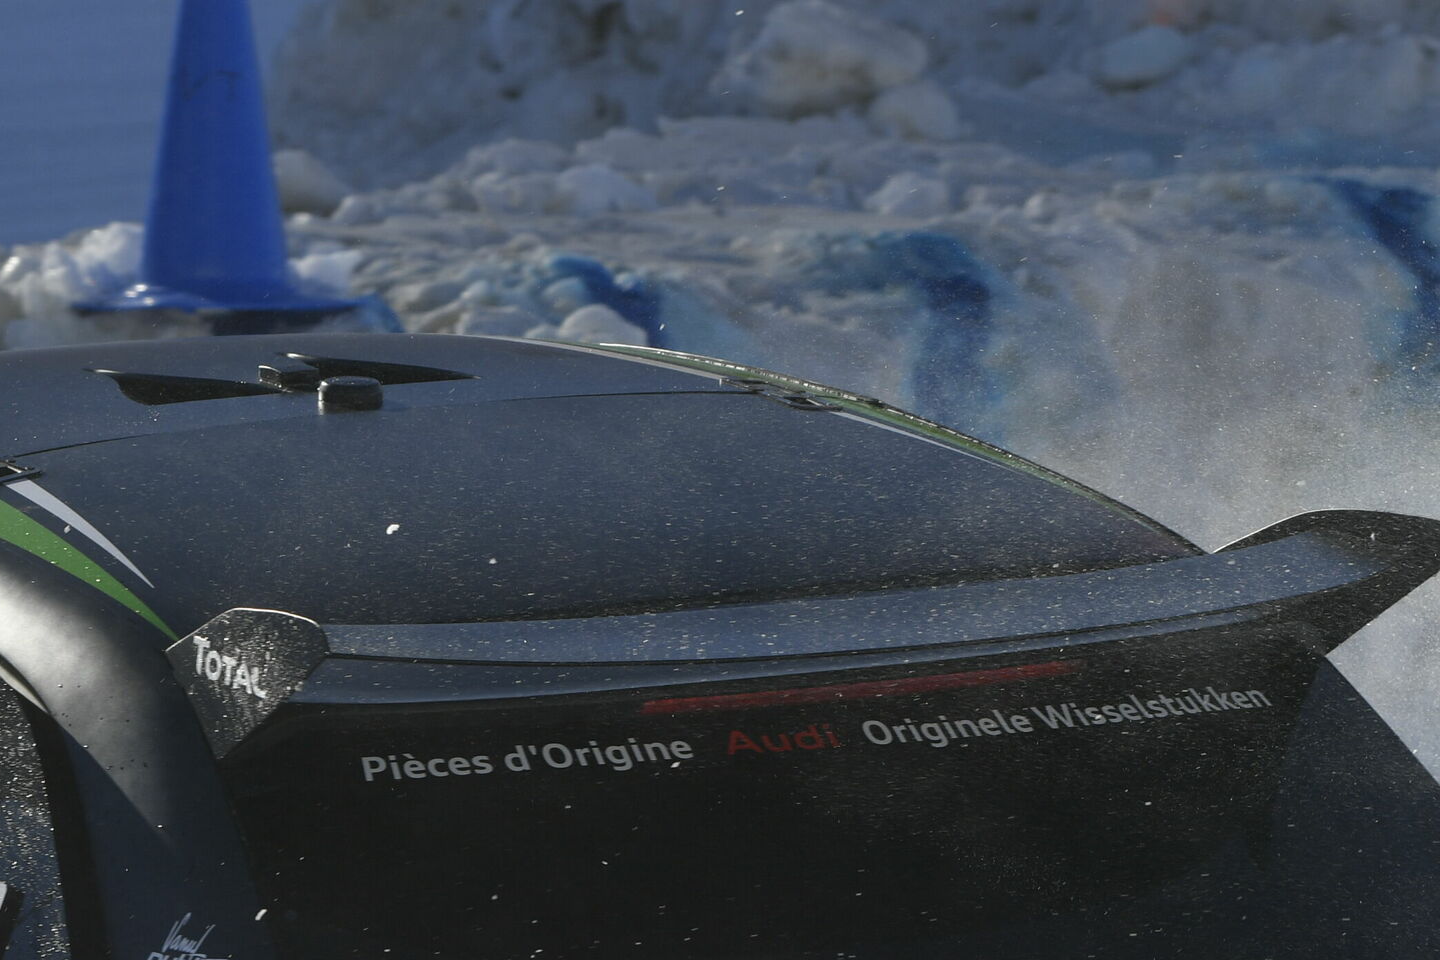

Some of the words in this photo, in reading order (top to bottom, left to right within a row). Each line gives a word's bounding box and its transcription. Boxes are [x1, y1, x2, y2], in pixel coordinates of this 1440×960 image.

[193, 635, 267, 698] TOTAL
[360, 751, 493, 782] Pièces
[504, 736, 694, 771] d'Origine
[726, 722, 838, 756] Audi
[862, 708, 1033, 749] Originele
[1033, 685, 1272, 730] Wisselstukken
